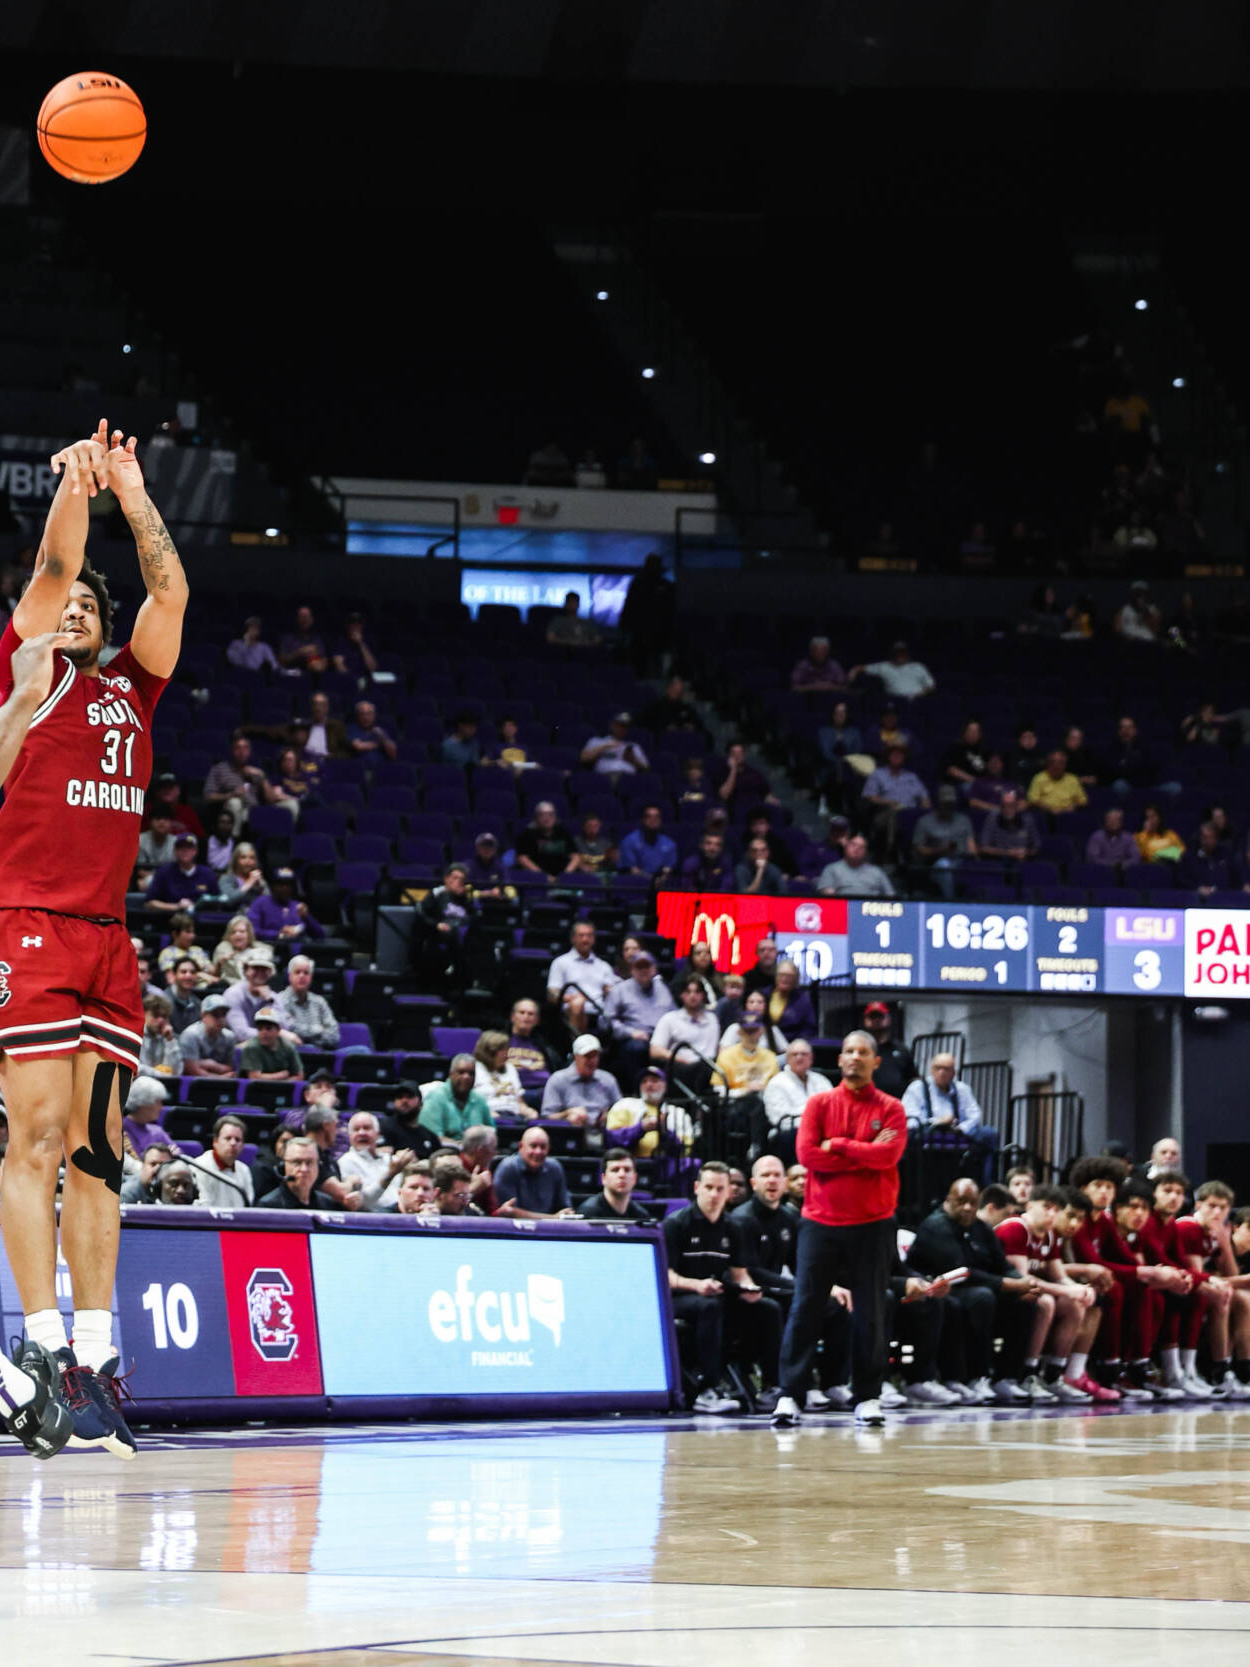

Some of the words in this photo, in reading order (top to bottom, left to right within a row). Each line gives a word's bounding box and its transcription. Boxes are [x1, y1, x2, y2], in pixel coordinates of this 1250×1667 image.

[100, 728, 136, 777] 31
[66, 779, 145, 816] CAROLIN
[875, 920, 891, 948] 1
[926, 913, 1029, 951] 16:26
[1057, 925, 1078, 953] 2
[1115, 916, 1176, 941] LSU
[1196, 923, 1250, 957] PA
[993, 960, 1008, 985] 1
[1132, 949, 1161, 991] 3
[142, 1282, 199, 1351] 10
[428, 1264, 531, 1343] efcu
[471, 1350, 534, 1367] FINANCIAL
